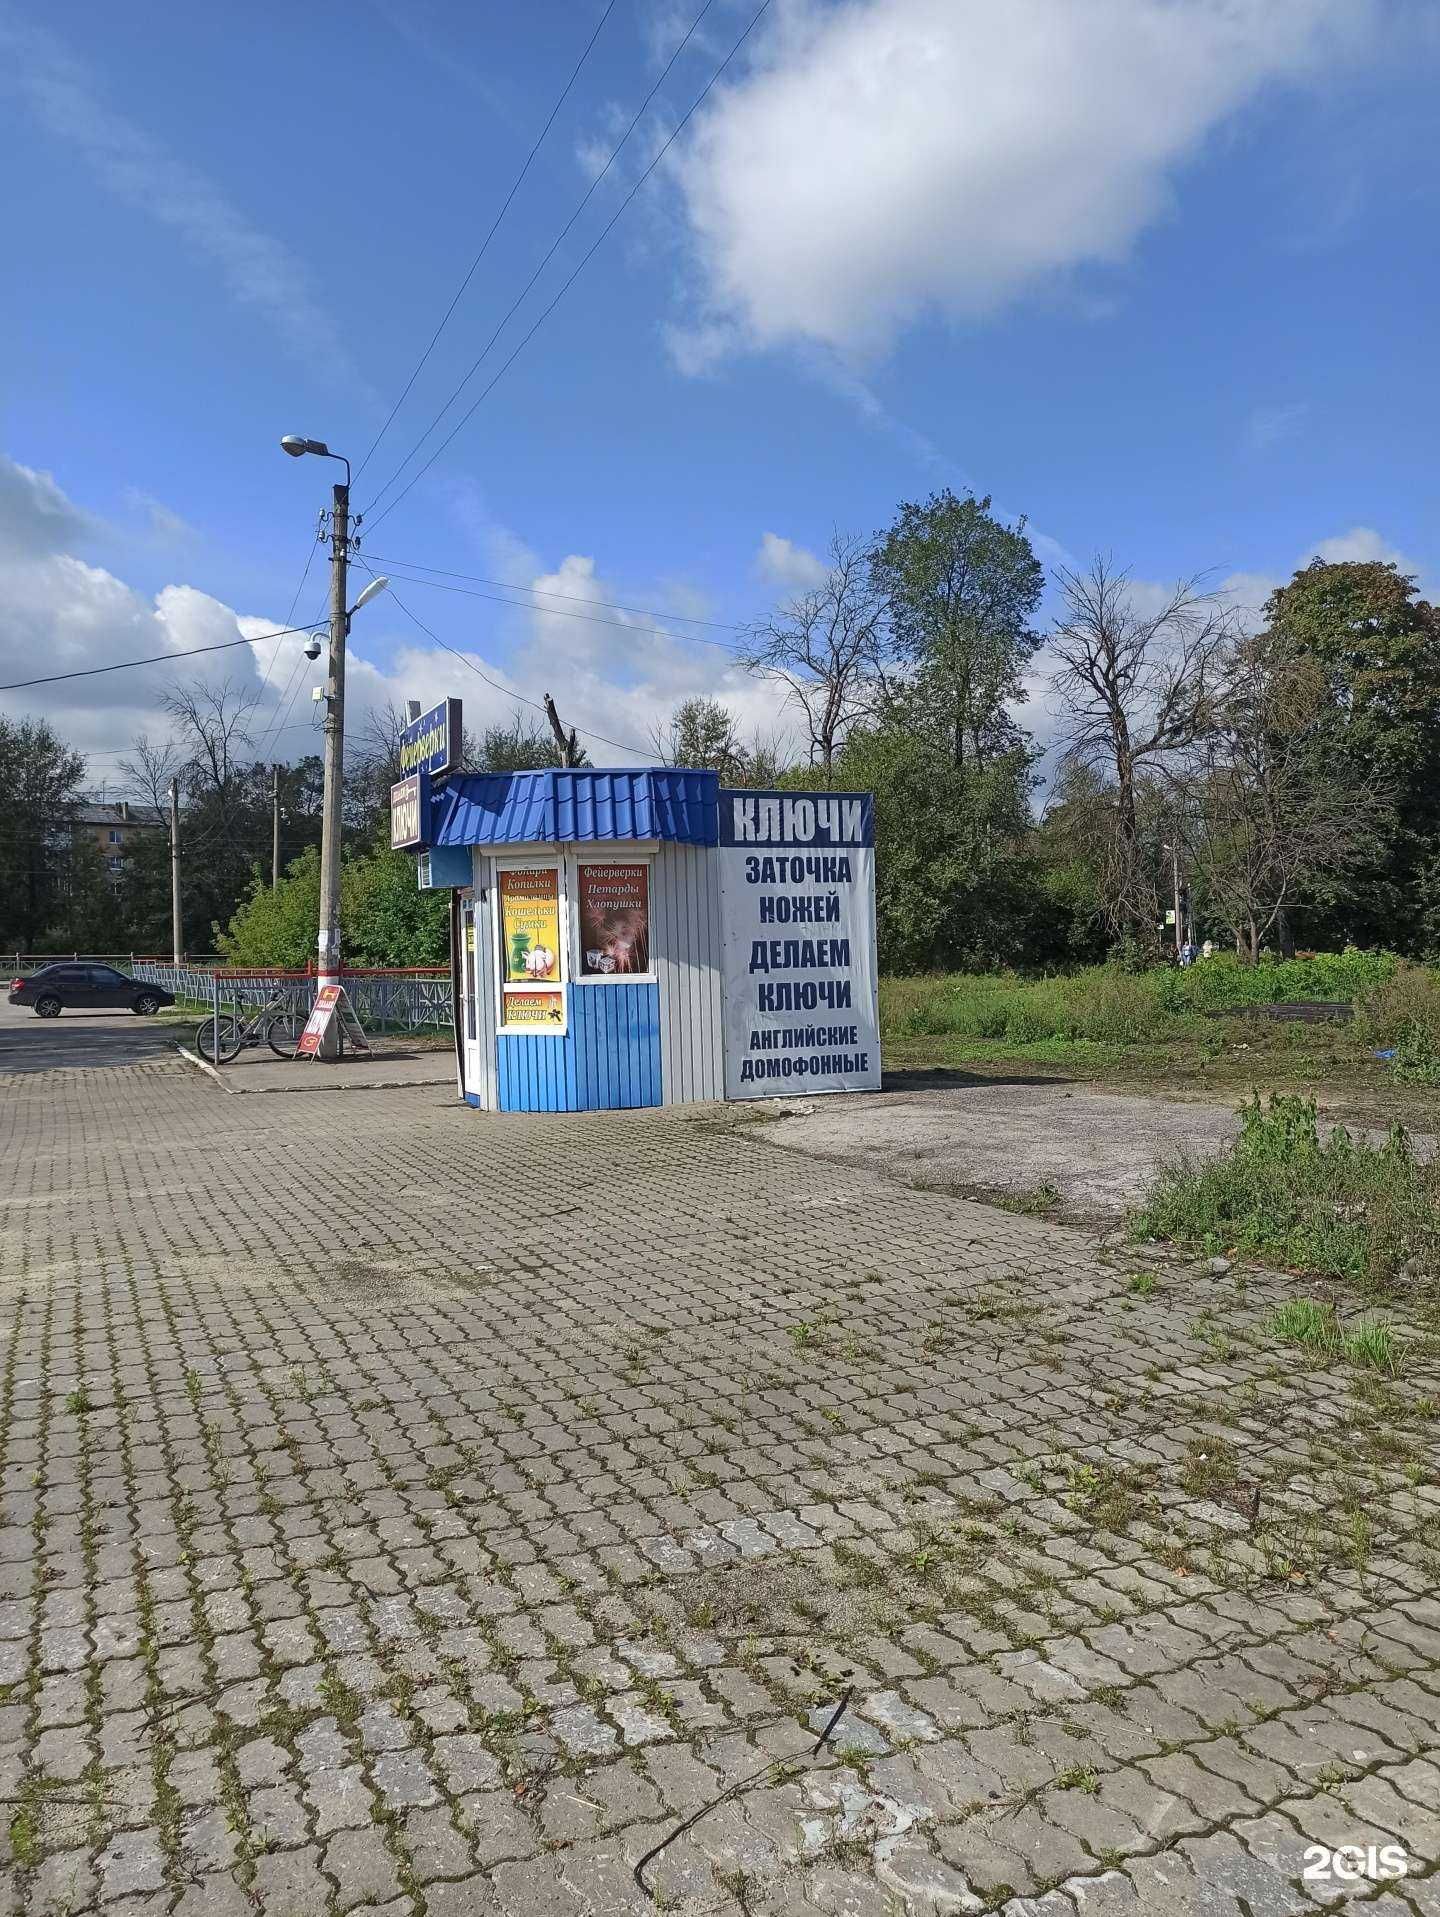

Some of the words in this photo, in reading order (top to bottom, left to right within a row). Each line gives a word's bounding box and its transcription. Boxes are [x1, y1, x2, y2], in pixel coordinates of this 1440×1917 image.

[401, 722, 446, 774] Фейерверки
[393, 800, 418, 843] КЛЮЧИ
[733, 797, 863, 842] КЛЮЧИ
[584, 865, 642, 880] Фейерверки
[745, 856, 852, 884] ЗАТОЧКА
[507, 879, 552, 890] Копилки
[588, 883, 639, 895] Петарды
[504, 906, 555, 916] Кошельки
[586, 899, 642, 911] Хлопушки
[759, 891, 840, 923] НОЖЕЙ
[513, 919, 547, 930] Сумки
[749, 938, 850, 974] ДЕЛАЕМ
[507, 996, 543, 1007] Делаем
[758, 980, 852, 1012] КЛЮЧИ
[750, 1024, 858, 1050] АНГЛИЙСКИЕ
[740, 1053, 868, 1082] ДОМОФОННЫЕ
